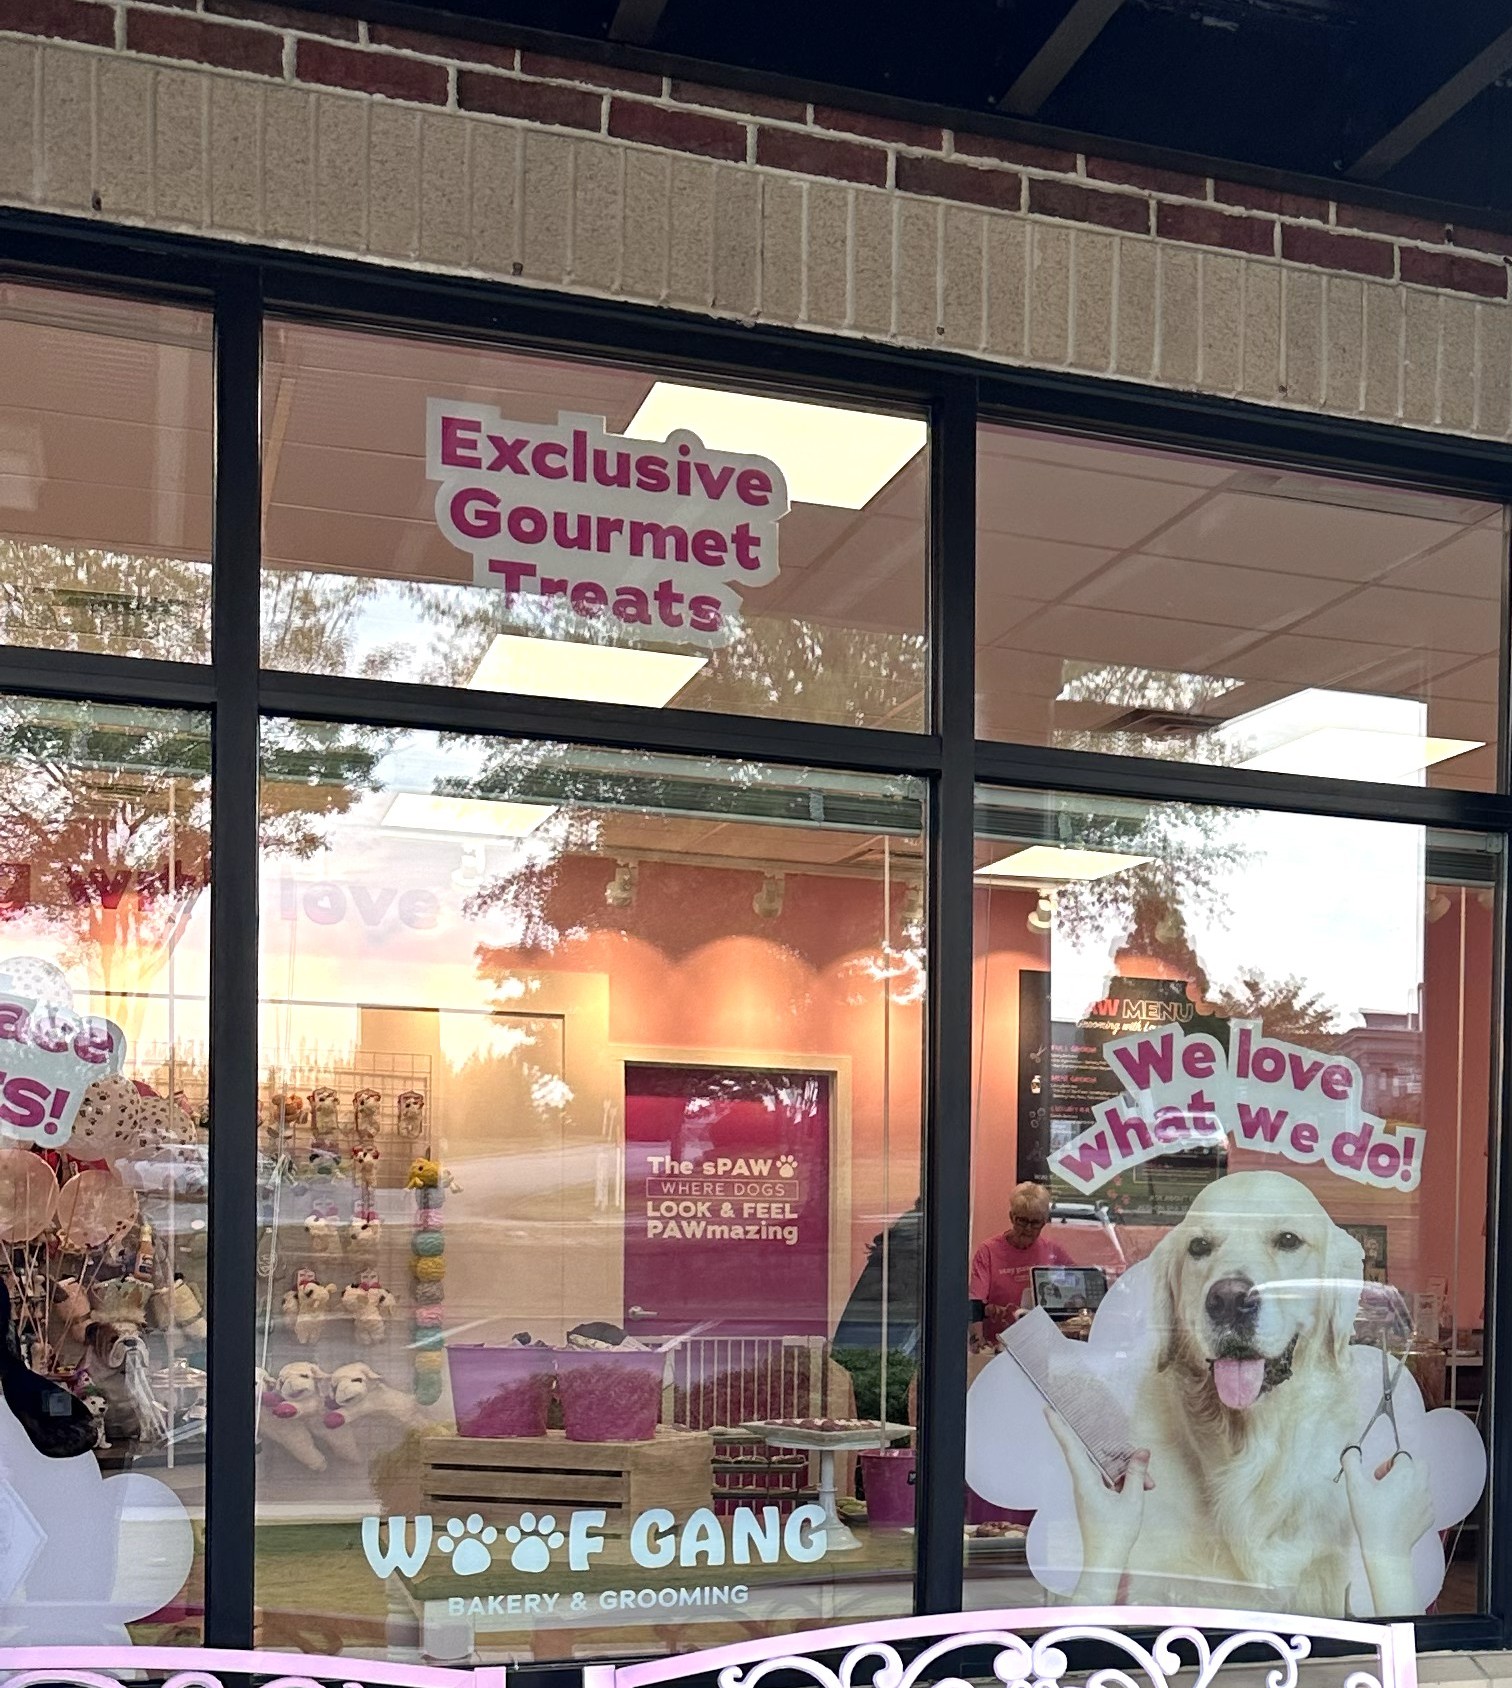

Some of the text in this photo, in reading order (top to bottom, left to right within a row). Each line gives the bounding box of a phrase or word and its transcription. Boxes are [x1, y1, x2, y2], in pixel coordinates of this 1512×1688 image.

[439, 414, 774, 507] Exclusive
[448, 486, 762, 571] Gourmet
[487, 559, 724, 633] Treats
[1122, 999, 1194, 1022] MENU
[1113, 1028, 1354, 1101] We love
[1058, 1089, 1419, 1183] what we do!
[647, 1155, 773, 1177] The sPAW
[661, 1181, 786, 1197] WHERE DOGS
[647, 1200, 799, 1219] LOOK & FEEL
[647, 1219, 799, 1246] PAWmazing
[629, 1503, 829, 1570] GANG
[448, 1585, 750, 1618] BAKERY & GROOMING
